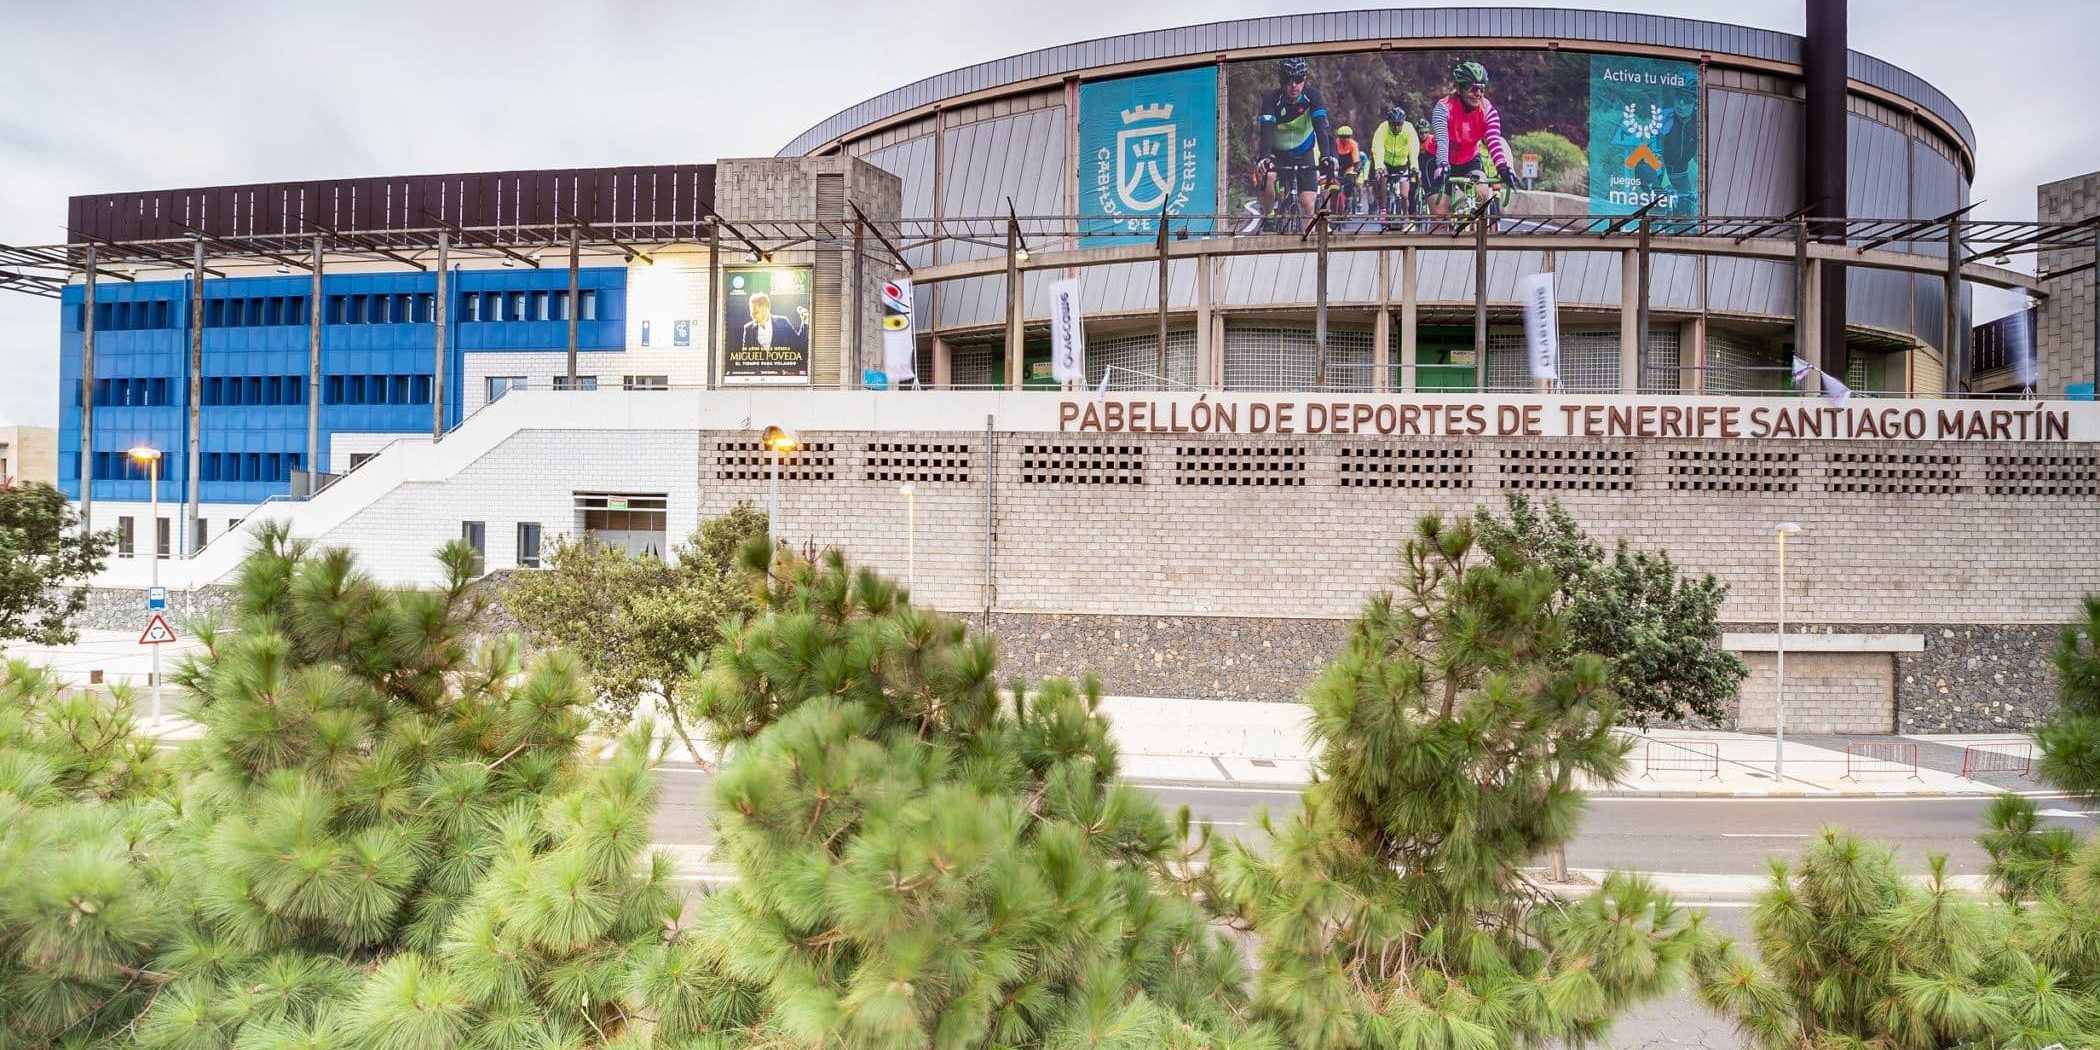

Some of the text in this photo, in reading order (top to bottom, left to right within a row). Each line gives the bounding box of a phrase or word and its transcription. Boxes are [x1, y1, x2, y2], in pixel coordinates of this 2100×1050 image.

[1603, 68, 1685, 86] Activa tu vida
[1609, 187, 1678, 209] máster
[730, 351, 803, 361] MIGUEL POVEDA
[1059, 393, 2069, 440] PABELLÓN DE DEPORTES DE TENERIFE SANTIAGO MARTÍN
